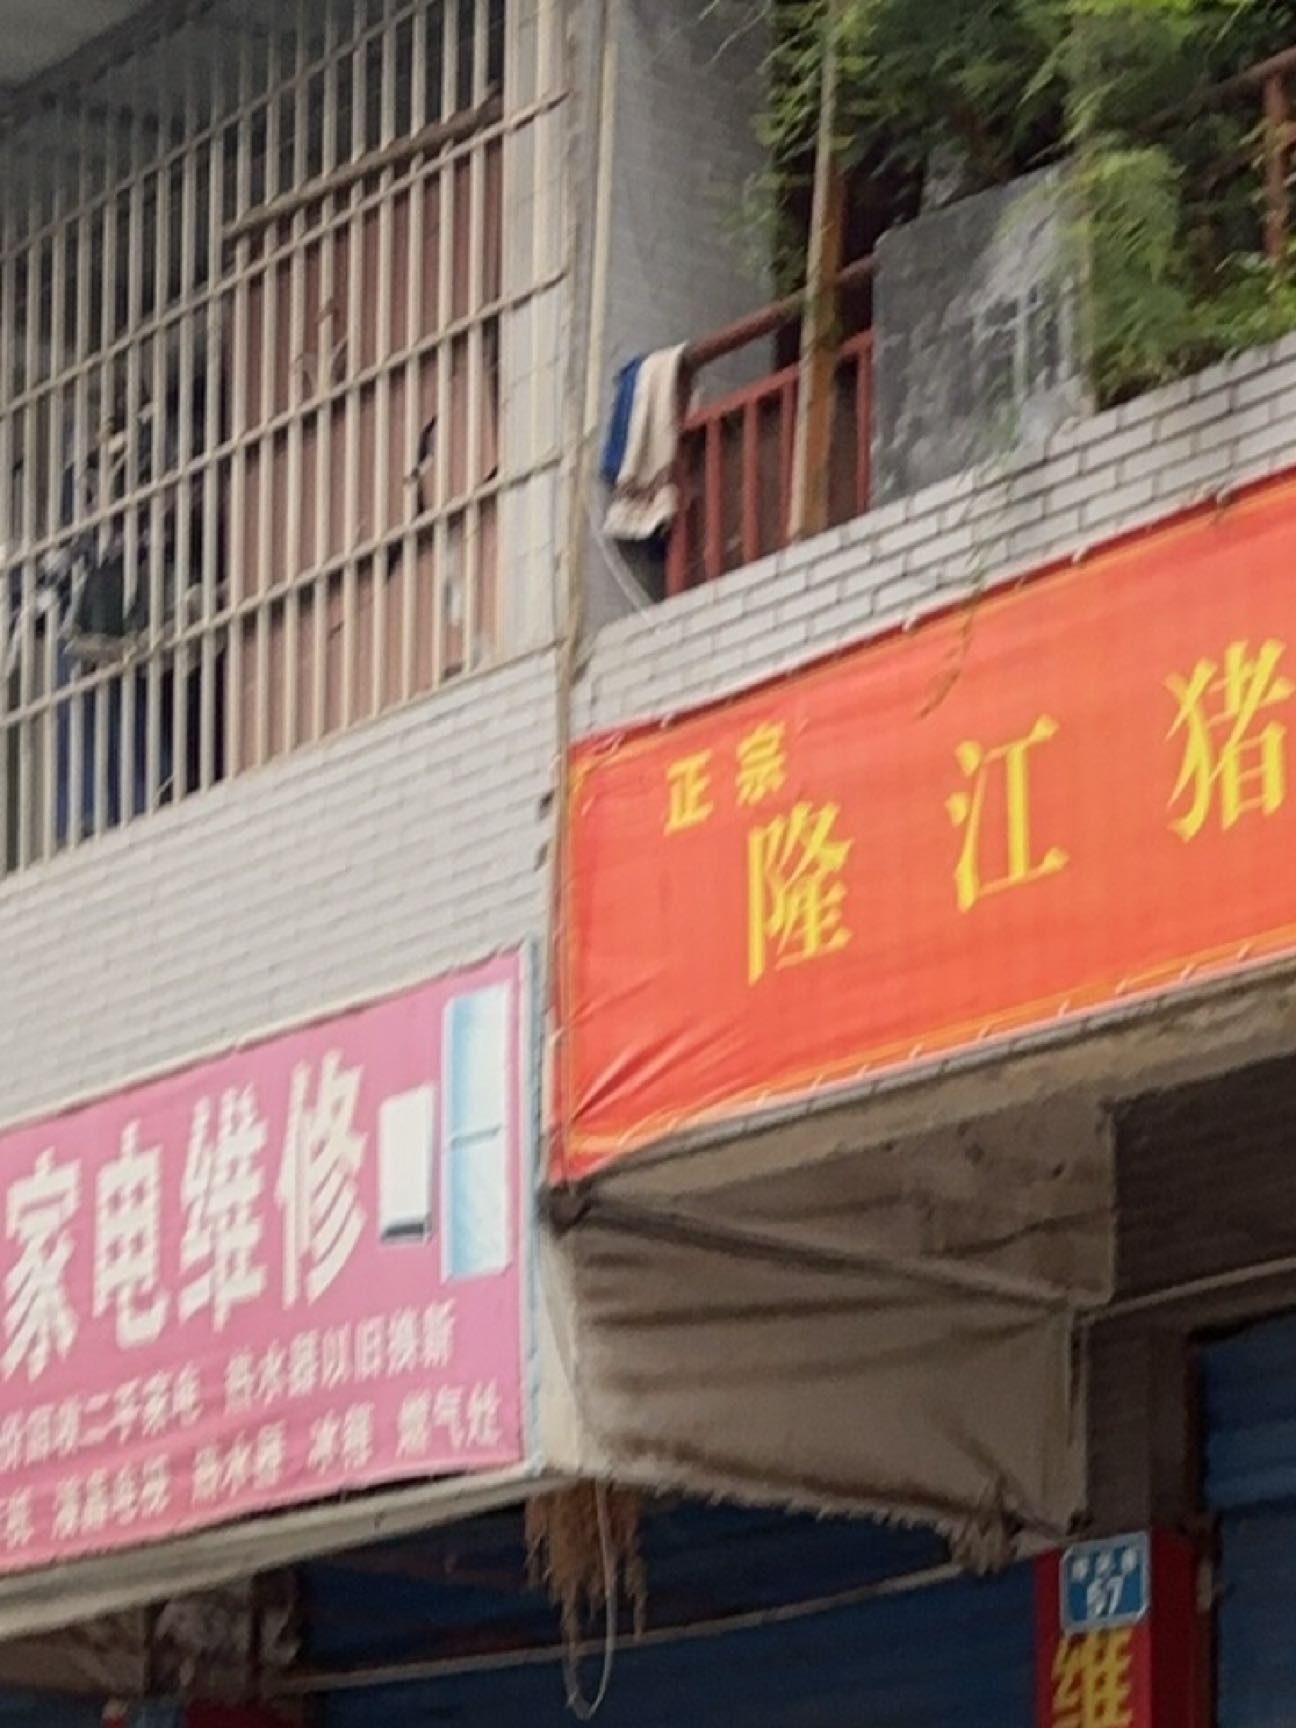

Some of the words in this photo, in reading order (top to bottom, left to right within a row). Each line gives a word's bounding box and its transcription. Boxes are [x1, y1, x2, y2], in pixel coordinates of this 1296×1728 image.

[663, 722, 789, 836] 正宗
[2, 1046, 368, 1382] 家电维修
